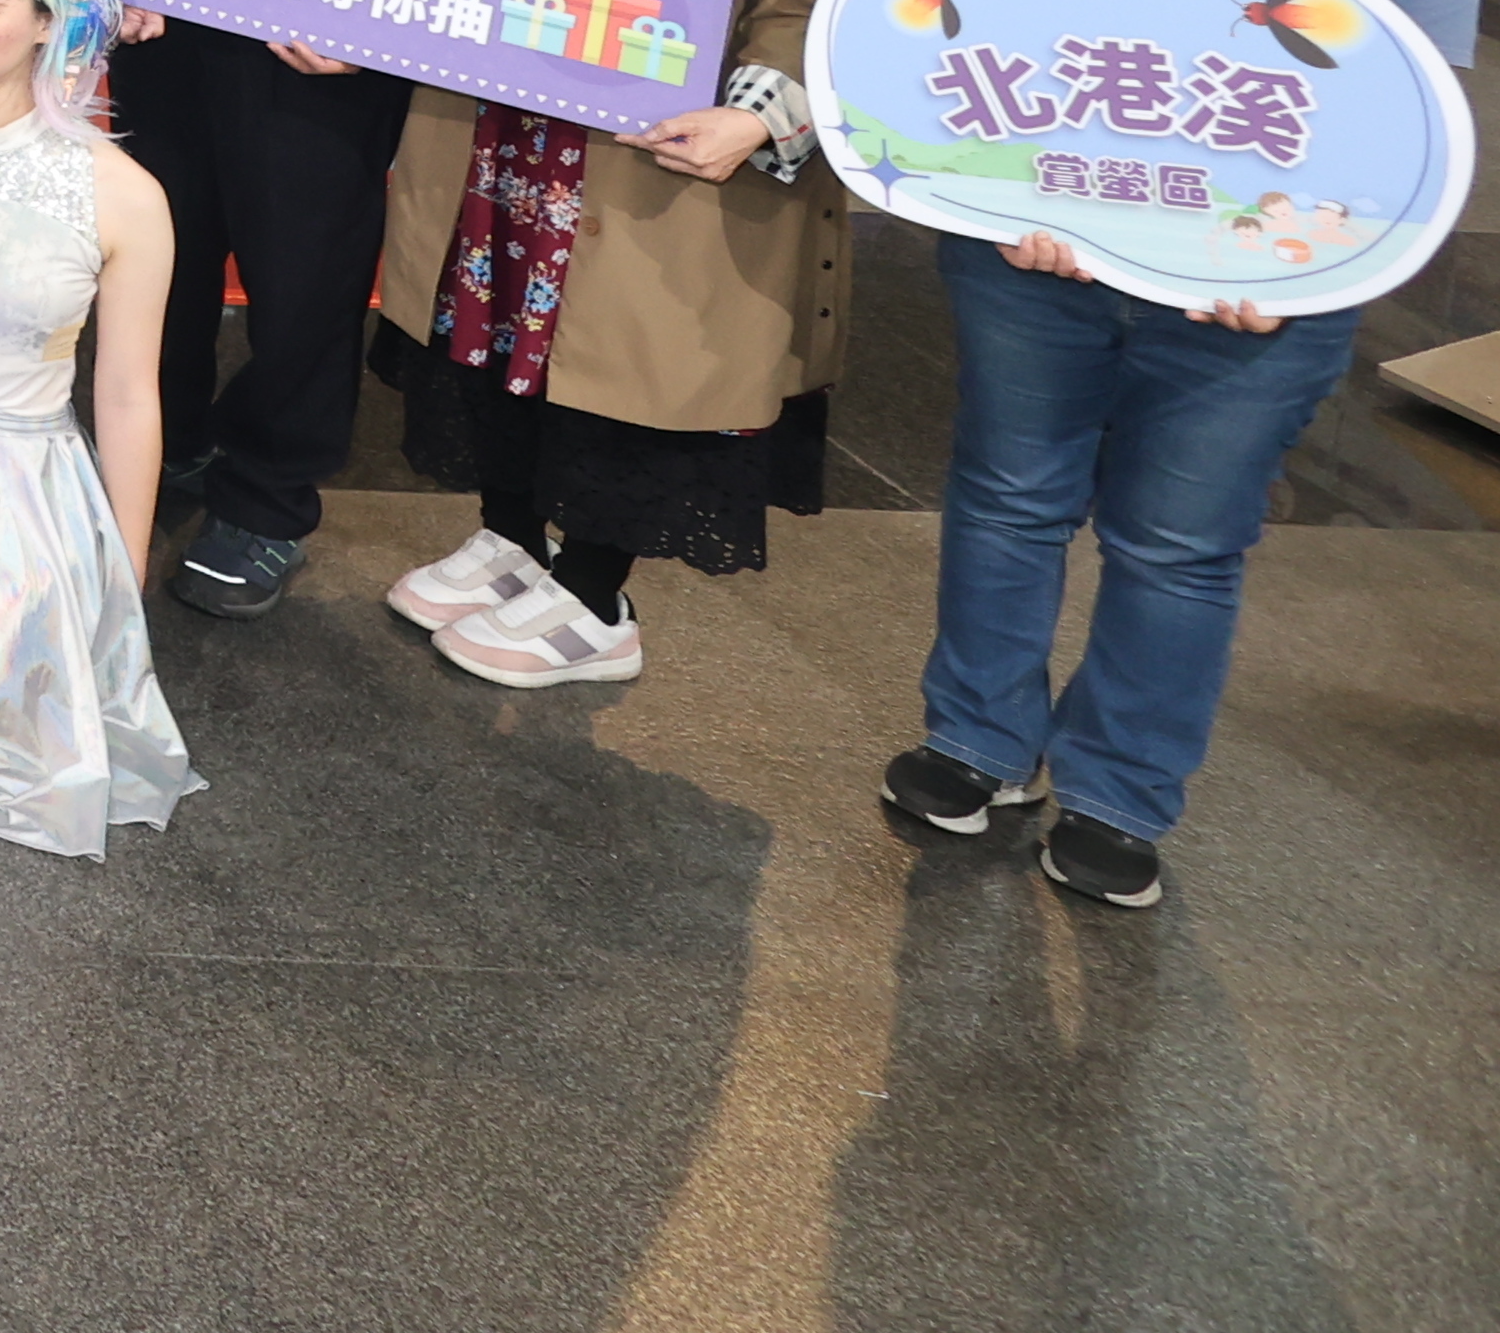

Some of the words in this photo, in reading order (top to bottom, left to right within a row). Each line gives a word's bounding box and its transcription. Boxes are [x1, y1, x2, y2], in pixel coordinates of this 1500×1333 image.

[928, 37, 1315, 165] 北港溪
[1035, 152, 1212, 211] 賞螢區
